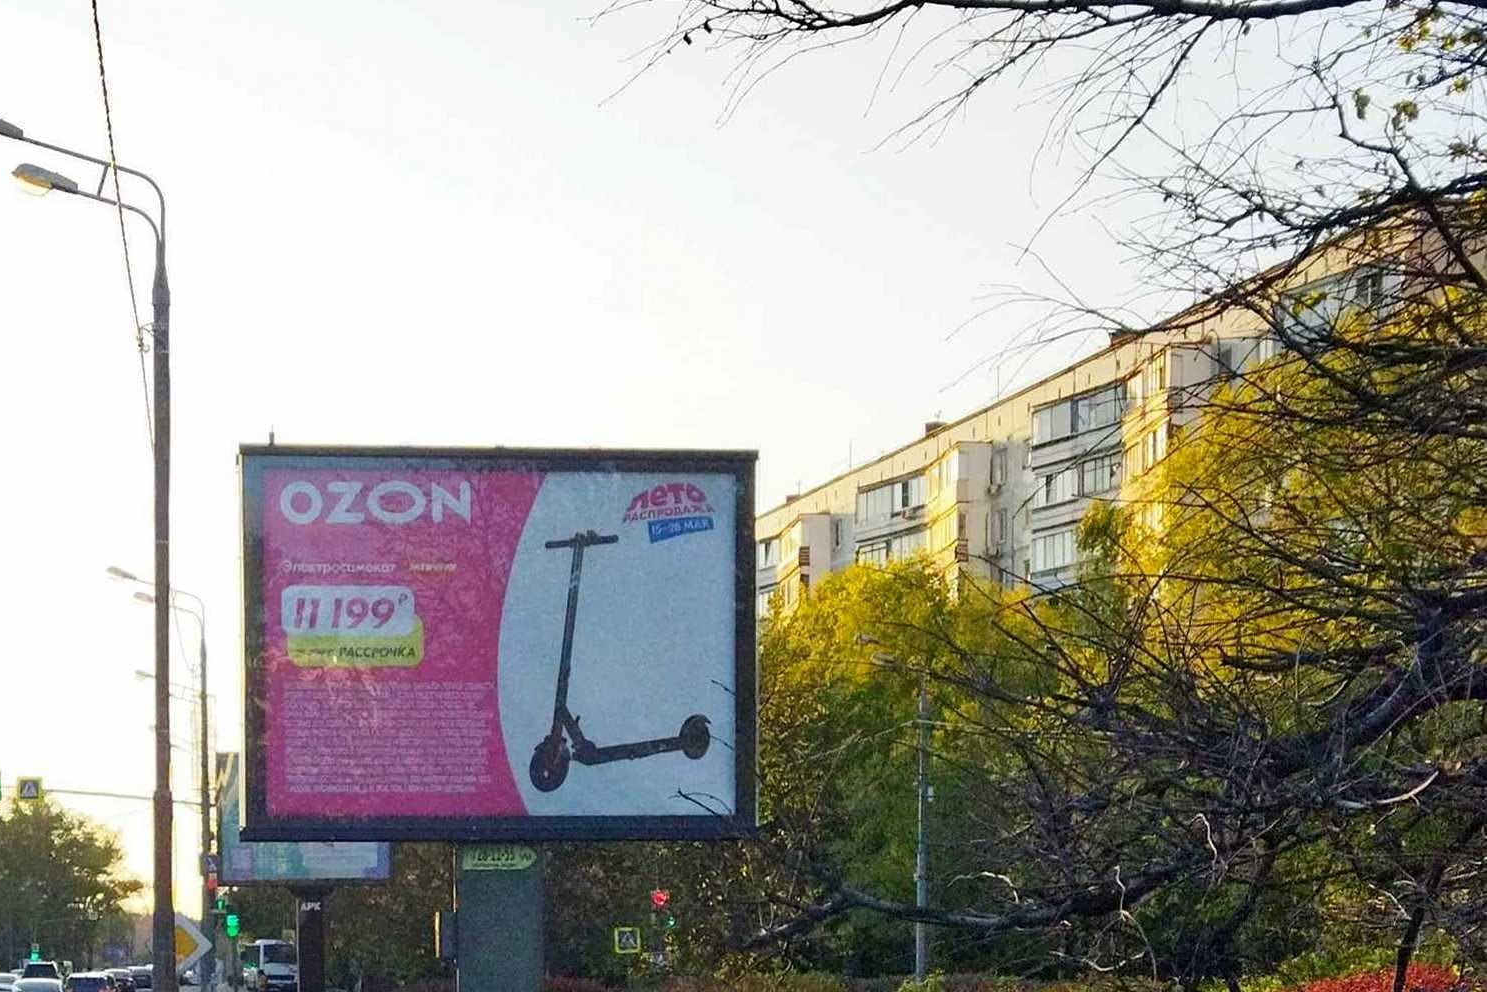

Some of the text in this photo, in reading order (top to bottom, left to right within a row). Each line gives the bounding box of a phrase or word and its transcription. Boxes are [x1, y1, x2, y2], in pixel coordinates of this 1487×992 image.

[279, 480, 472, 524] OZON
[293, 597, 321, 630] 11
[331, 597, 396, 630] 199
[338, 646, 417, 659] РАССРОЧКА
